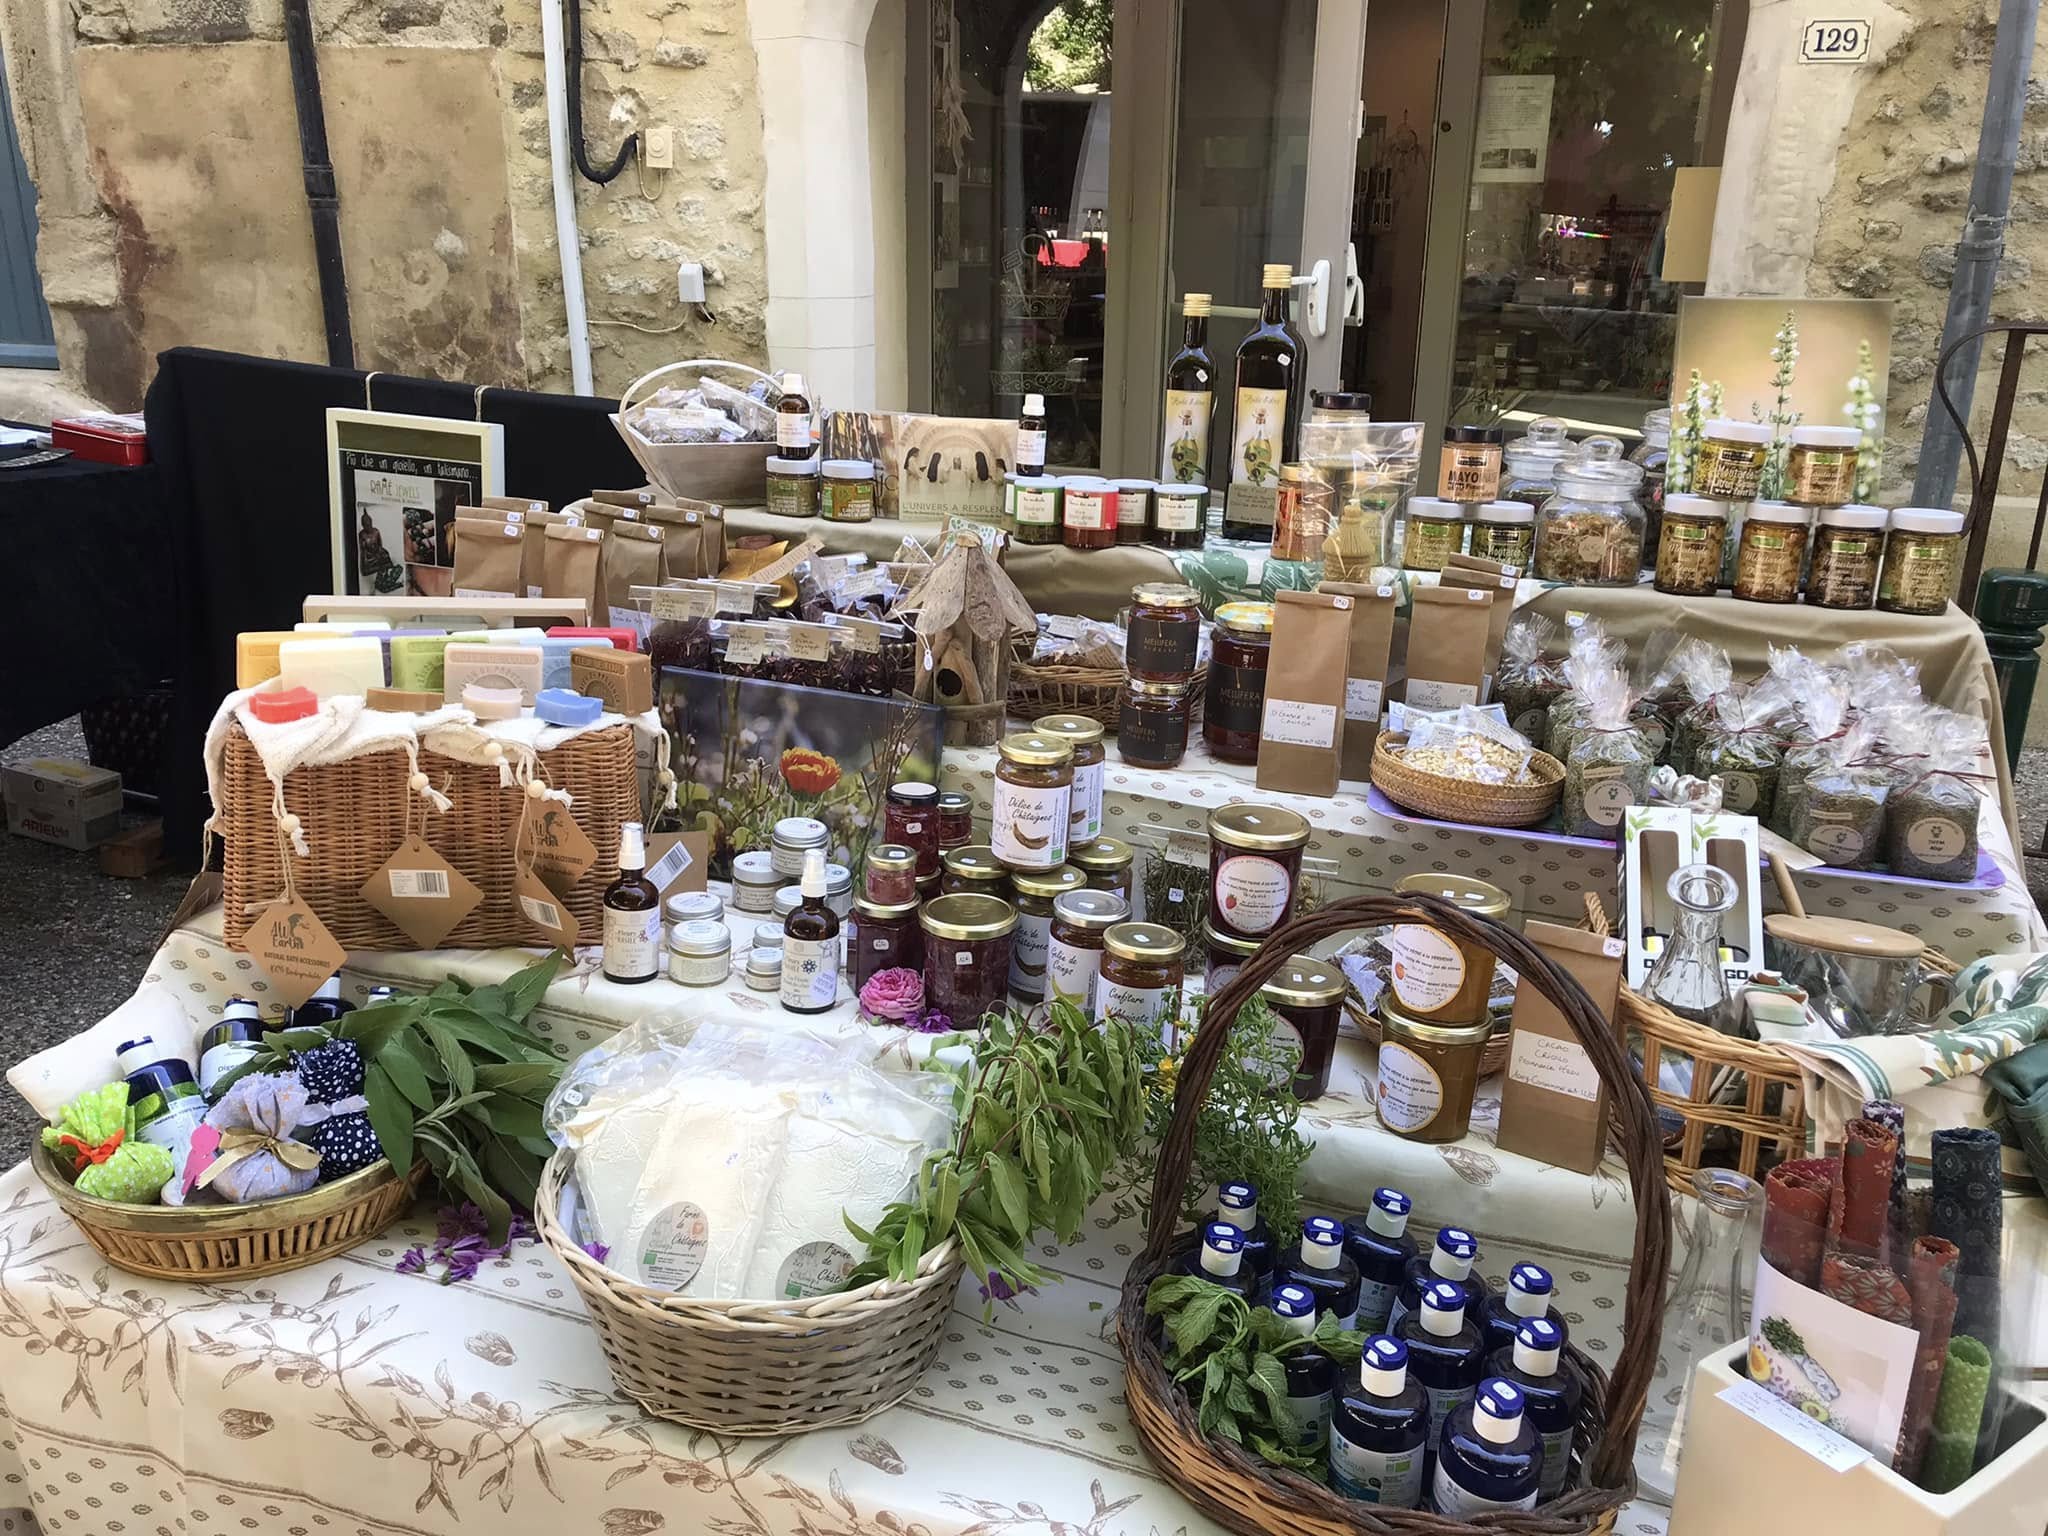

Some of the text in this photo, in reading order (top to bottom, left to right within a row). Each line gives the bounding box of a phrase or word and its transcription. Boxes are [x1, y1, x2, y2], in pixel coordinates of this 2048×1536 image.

[1813, 28, 1858, 53] 129
[360, 454, 375, 467] che
[379, 458, 389, 468] un
[422, 463, 433, 472] un
[902, 503, 949, 513] L'UNIVERS
[963, 504, 1003, 515] RESPLEN
[1008, 796, 1043, 811] Délice de
[264, 951, 285, 962] NATURAL
[675, 1221, 685, 1230] de
[825, 1242, 852, 1260] Farine
[821, 1256, 832, 1266] de
